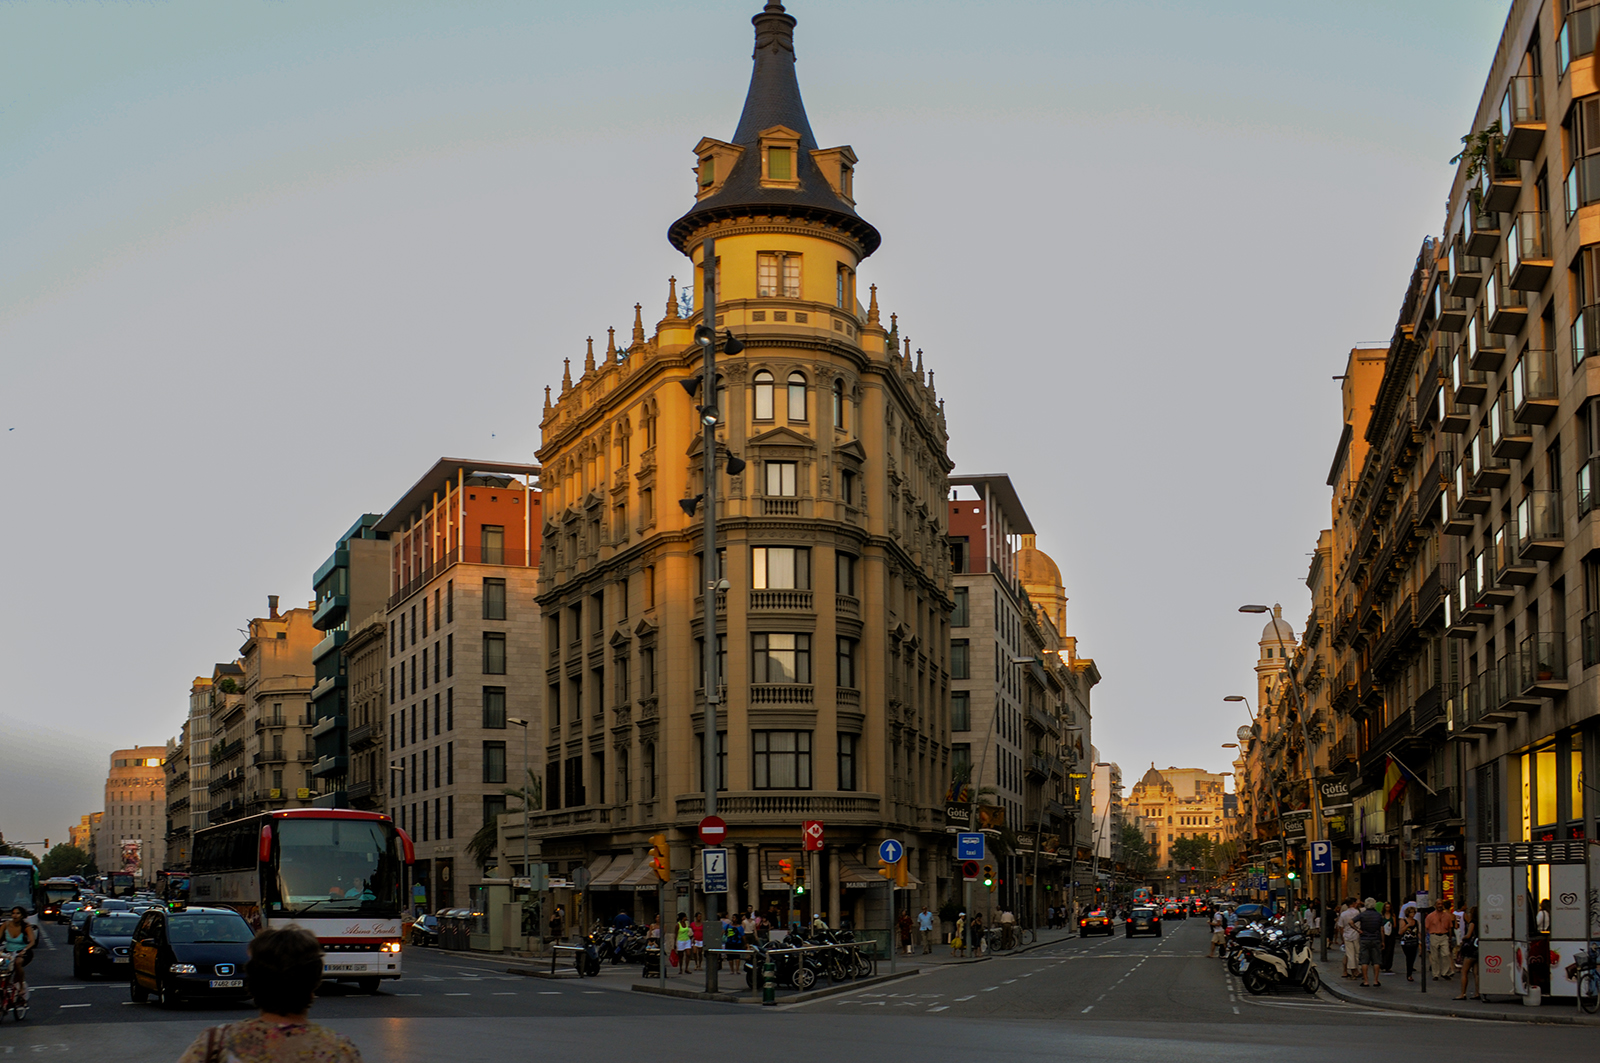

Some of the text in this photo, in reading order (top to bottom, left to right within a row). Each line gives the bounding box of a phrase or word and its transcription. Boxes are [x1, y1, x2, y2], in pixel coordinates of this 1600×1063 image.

[1323, 586, 1332, 648] HOTEL
[1321, 782, 1348, 795] Gòtic
[947, 806, 969, 818] Gòtic
[812, 827, 820, 835] M
[1313, 843, 1329, 861] P
[711, 855, 719, 872] i
[1261, 877, 1267, 885] P
[342, 922, 396, 935] Alsina Graells
